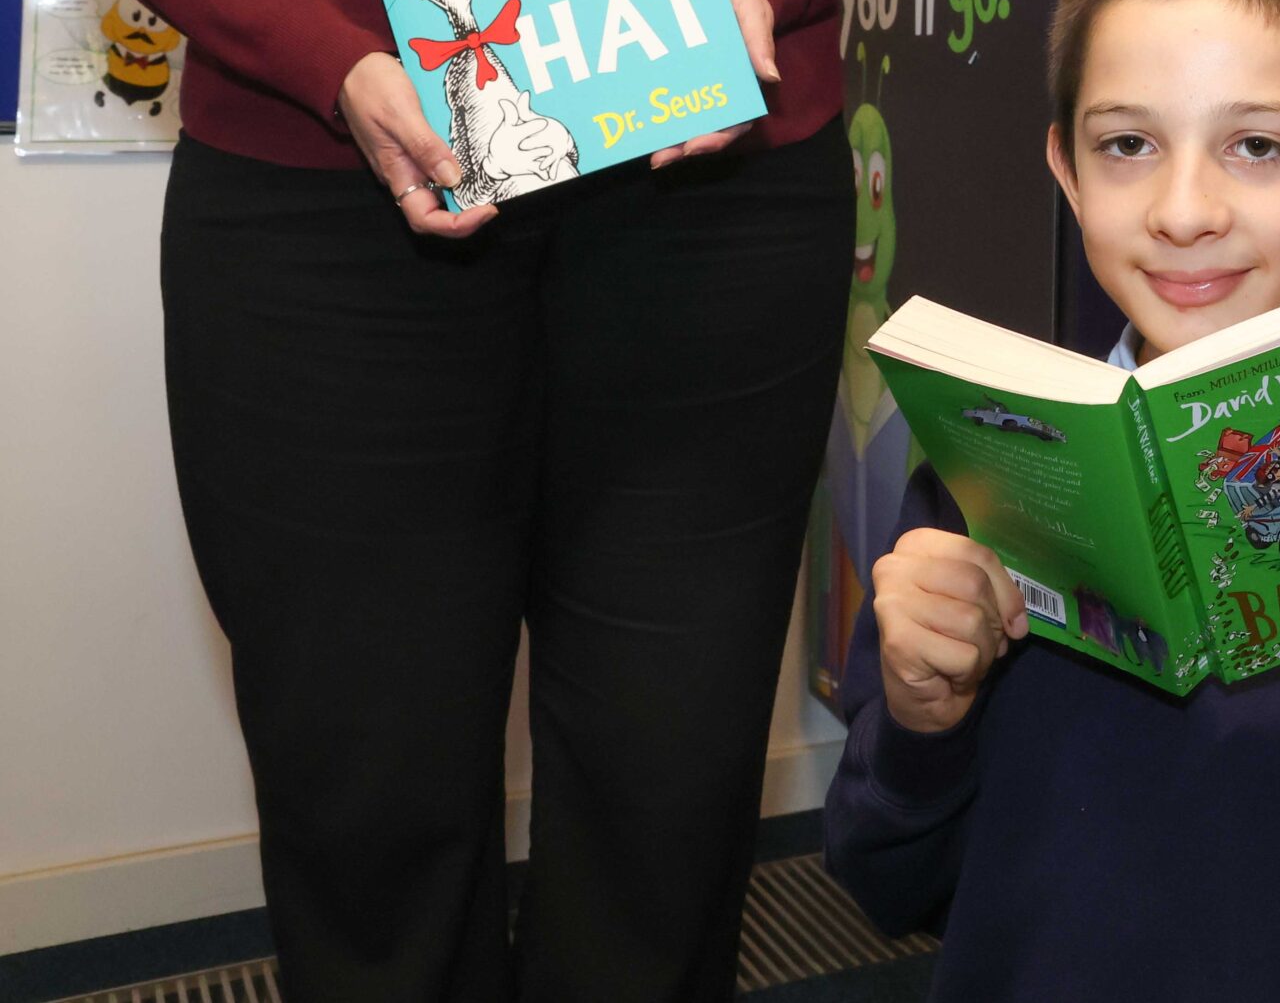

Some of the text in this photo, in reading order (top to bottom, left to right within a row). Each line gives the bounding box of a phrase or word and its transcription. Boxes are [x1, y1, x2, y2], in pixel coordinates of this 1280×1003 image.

[592, 83, 728, 149] Dr. Seuss
[1127, 395, 1159, 485] David Walliams
[1166, 375, 1272, 443] David
